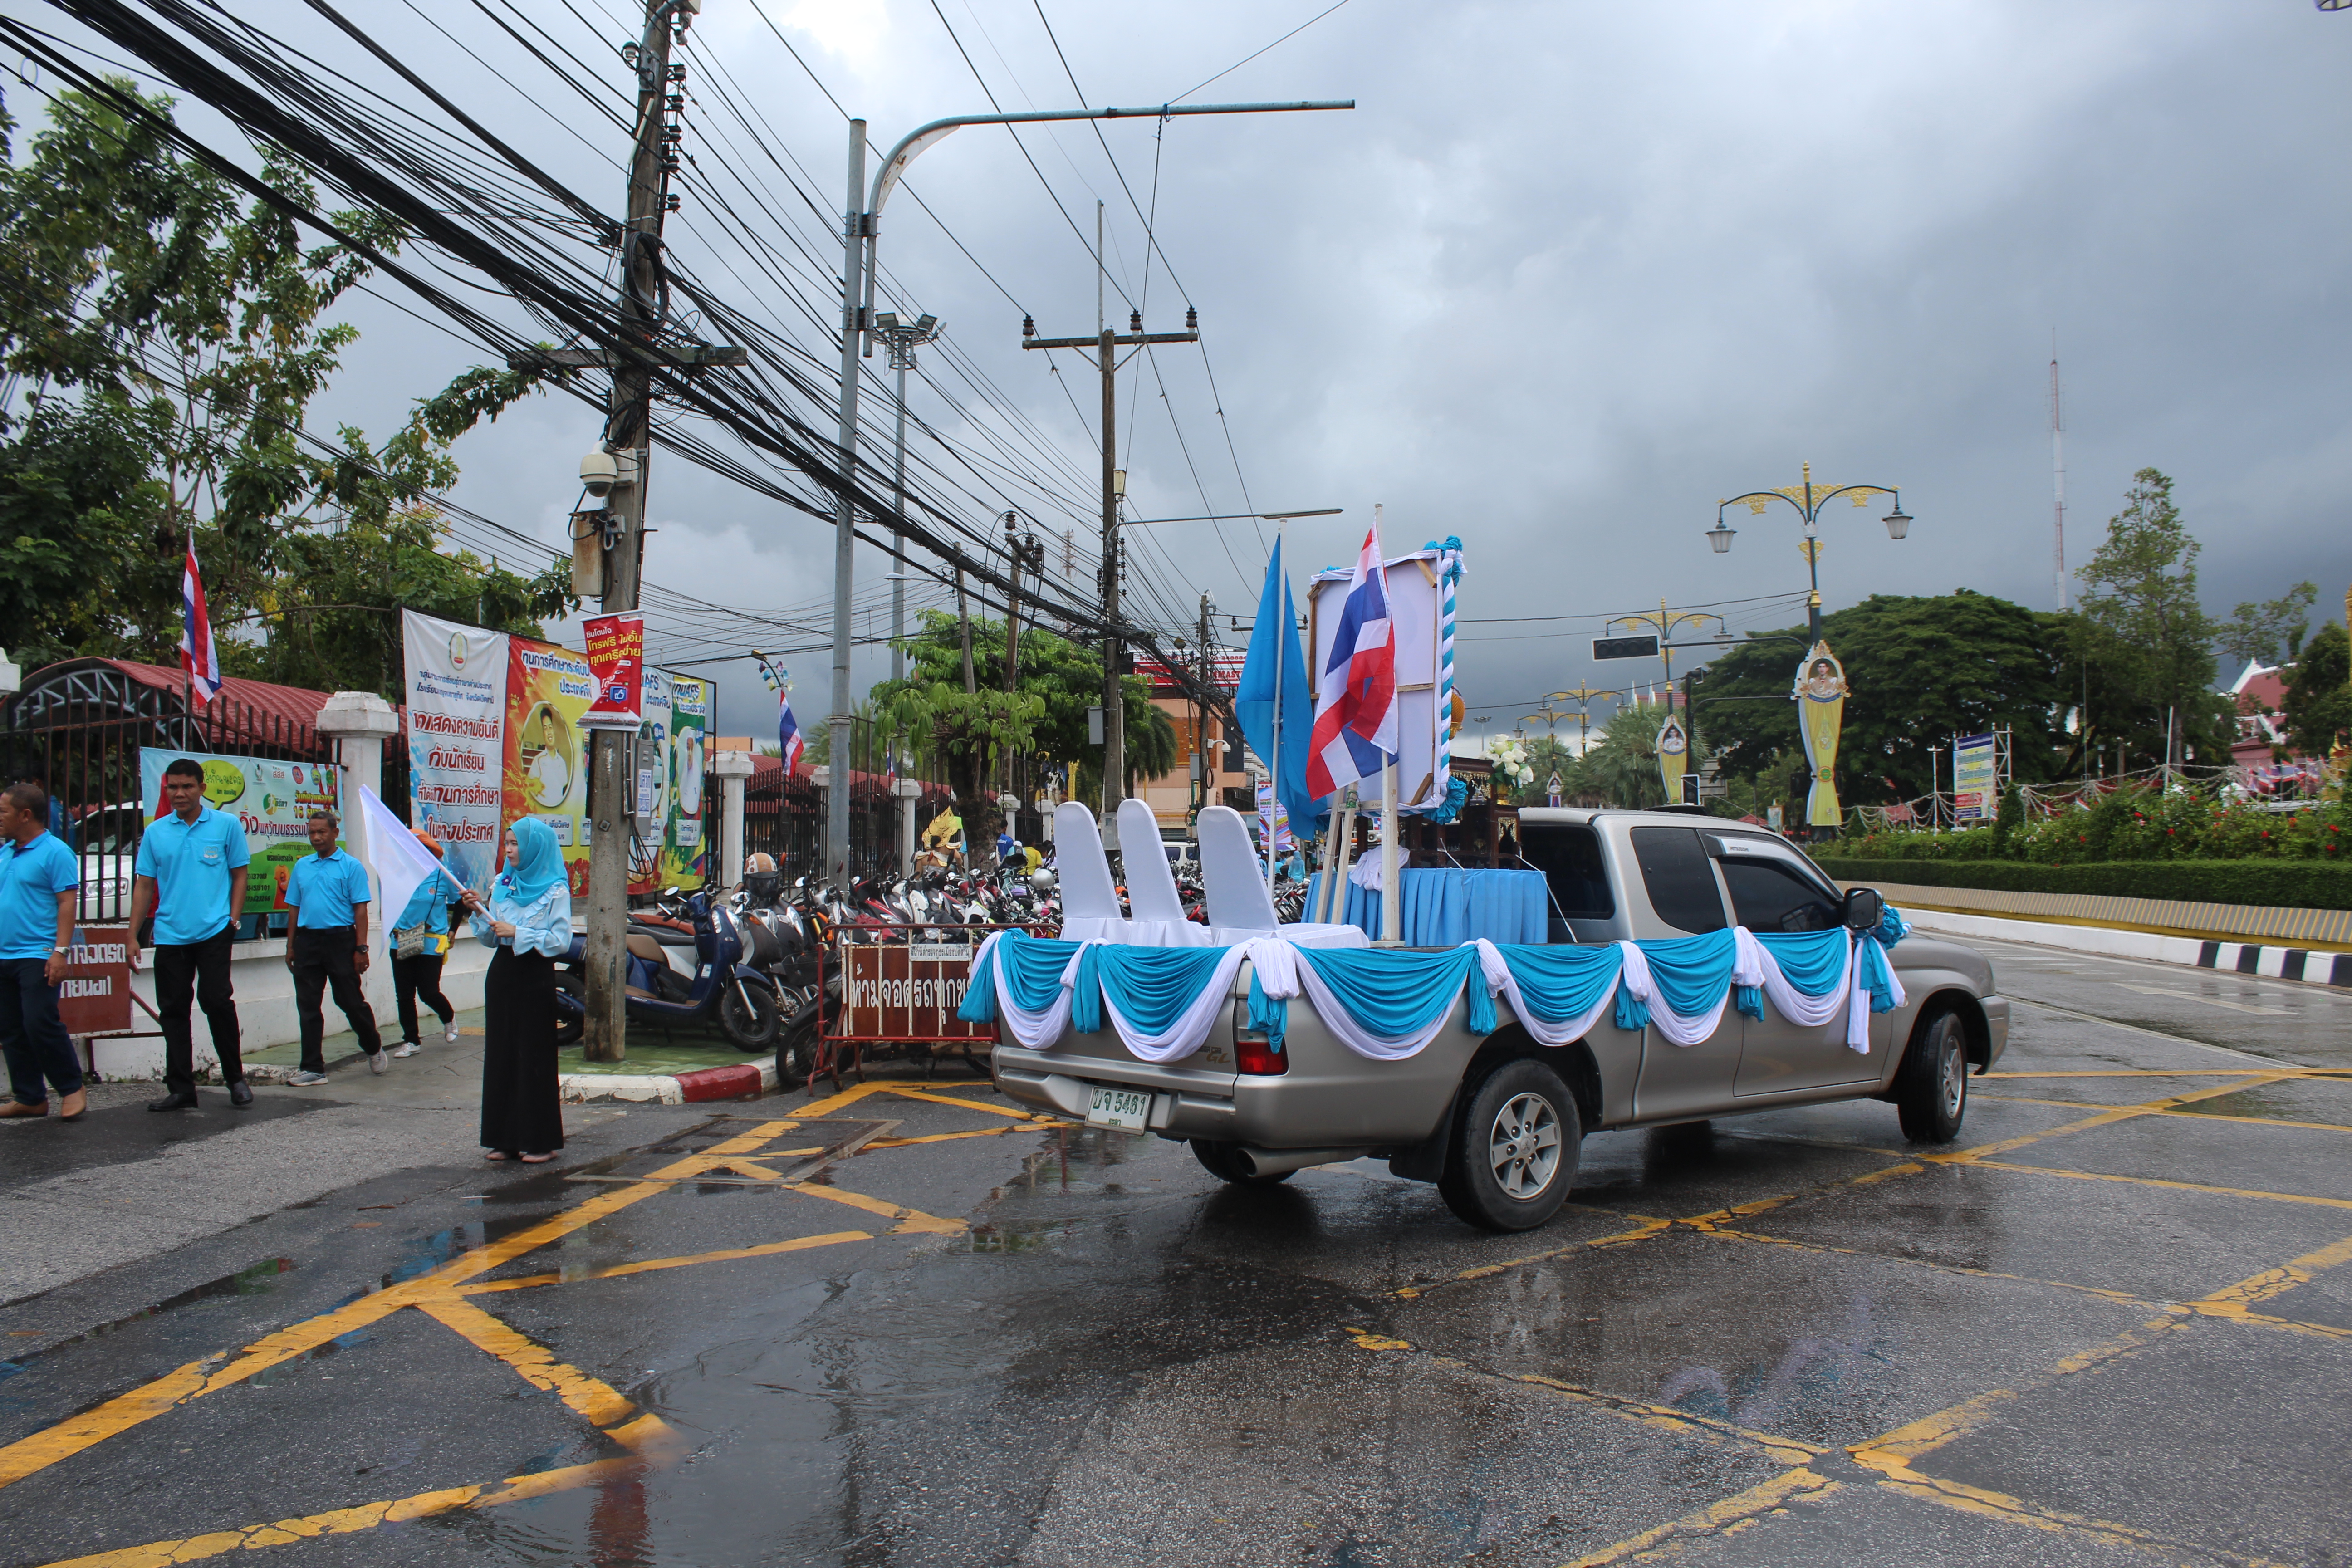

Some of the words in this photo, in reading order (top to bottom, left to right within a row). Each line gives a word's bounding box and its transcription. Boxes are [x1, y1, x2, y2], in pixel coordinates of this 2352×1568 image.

[586, 626, 612, 638] ซิมโดนใจ
[588, 636, 617, 651] โทรฟรี
[618, 630, 642, 644] ไม่อั้น
[428, 745, 485, 772] กับนักเรียน
[293, 806, 304, 819] 16
[1206, 1052, 1231, 1064] GL
[1114, 1093, 1147, 1116] 5461
